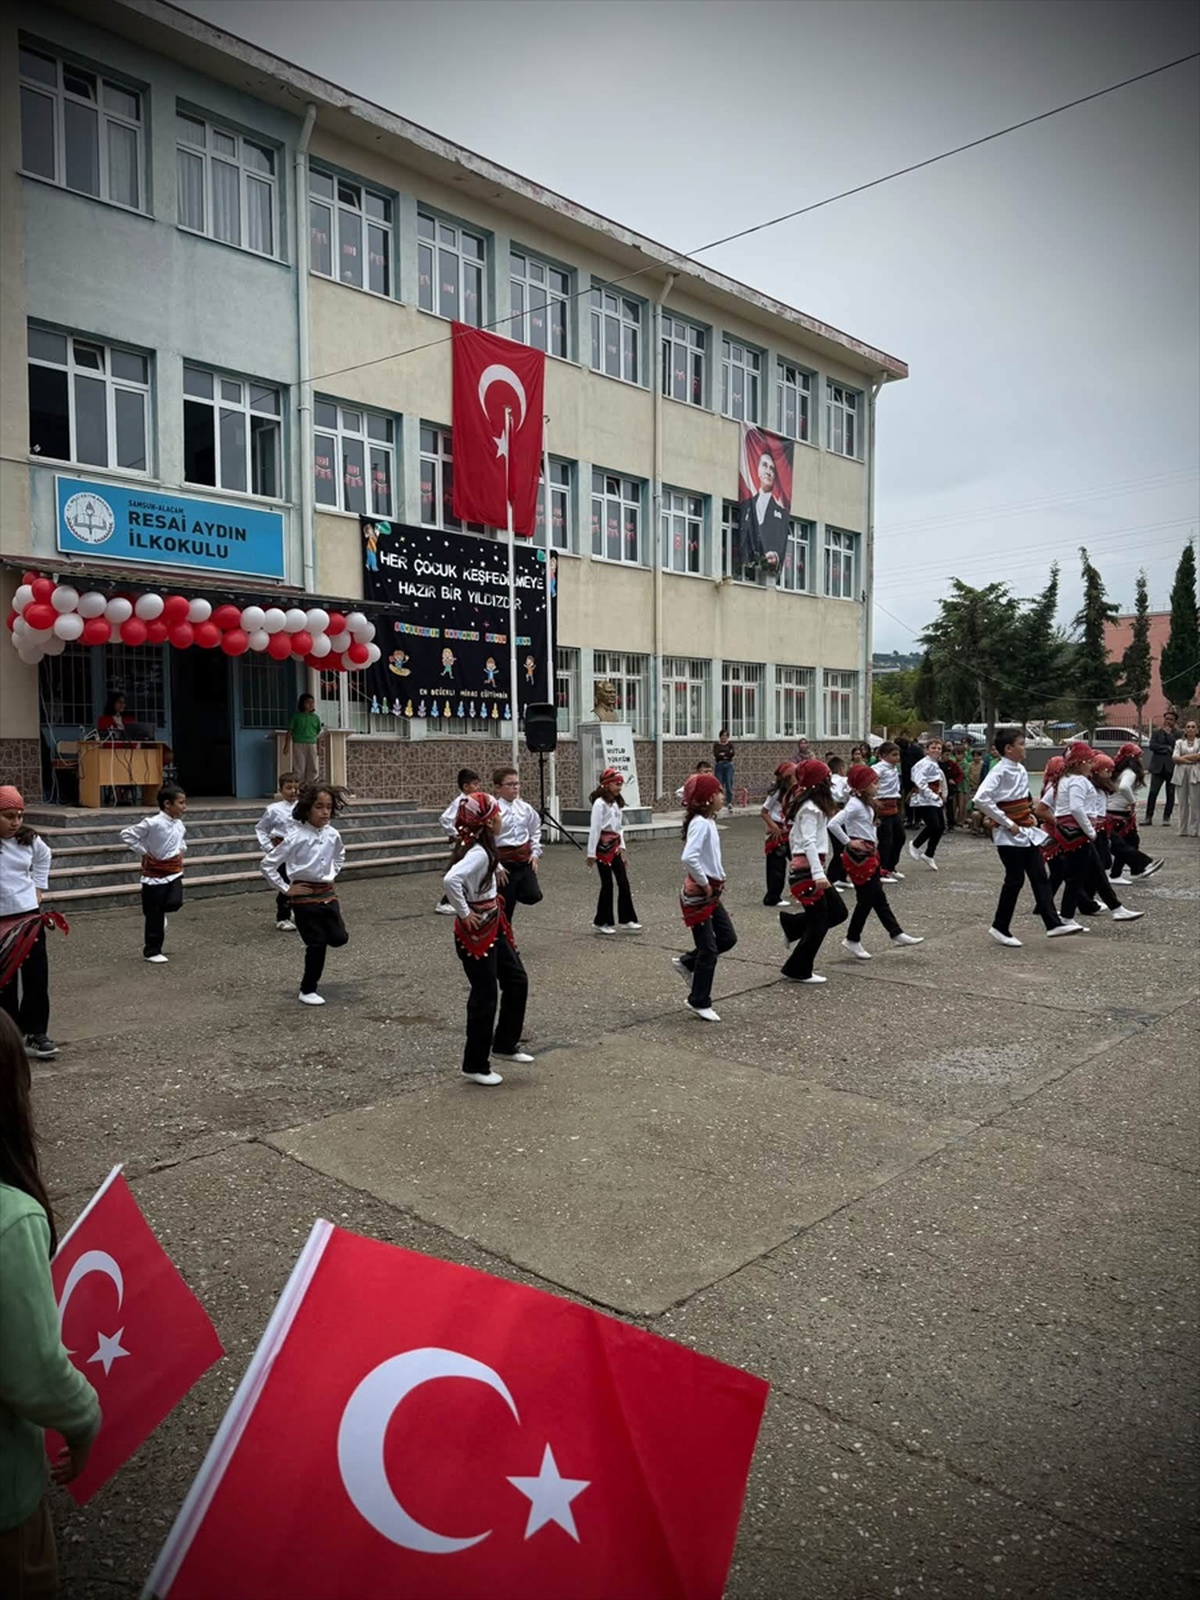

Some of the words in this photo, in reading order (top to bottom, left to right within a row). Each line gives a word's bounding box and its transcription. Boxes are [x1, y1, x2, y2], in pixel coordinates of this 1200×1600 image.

[128, 511, 186, 532] RESAİ
[192, 521, 246, 541] AYDIN
[129, 529, 228, 558] İLKOKULU
[380, 551, 408, 570] HER
[413, 558, 458, 579] ÇOCUK
[398, 580, 436, 599] HAZIR
[441, 583, 462, 602] BİR
